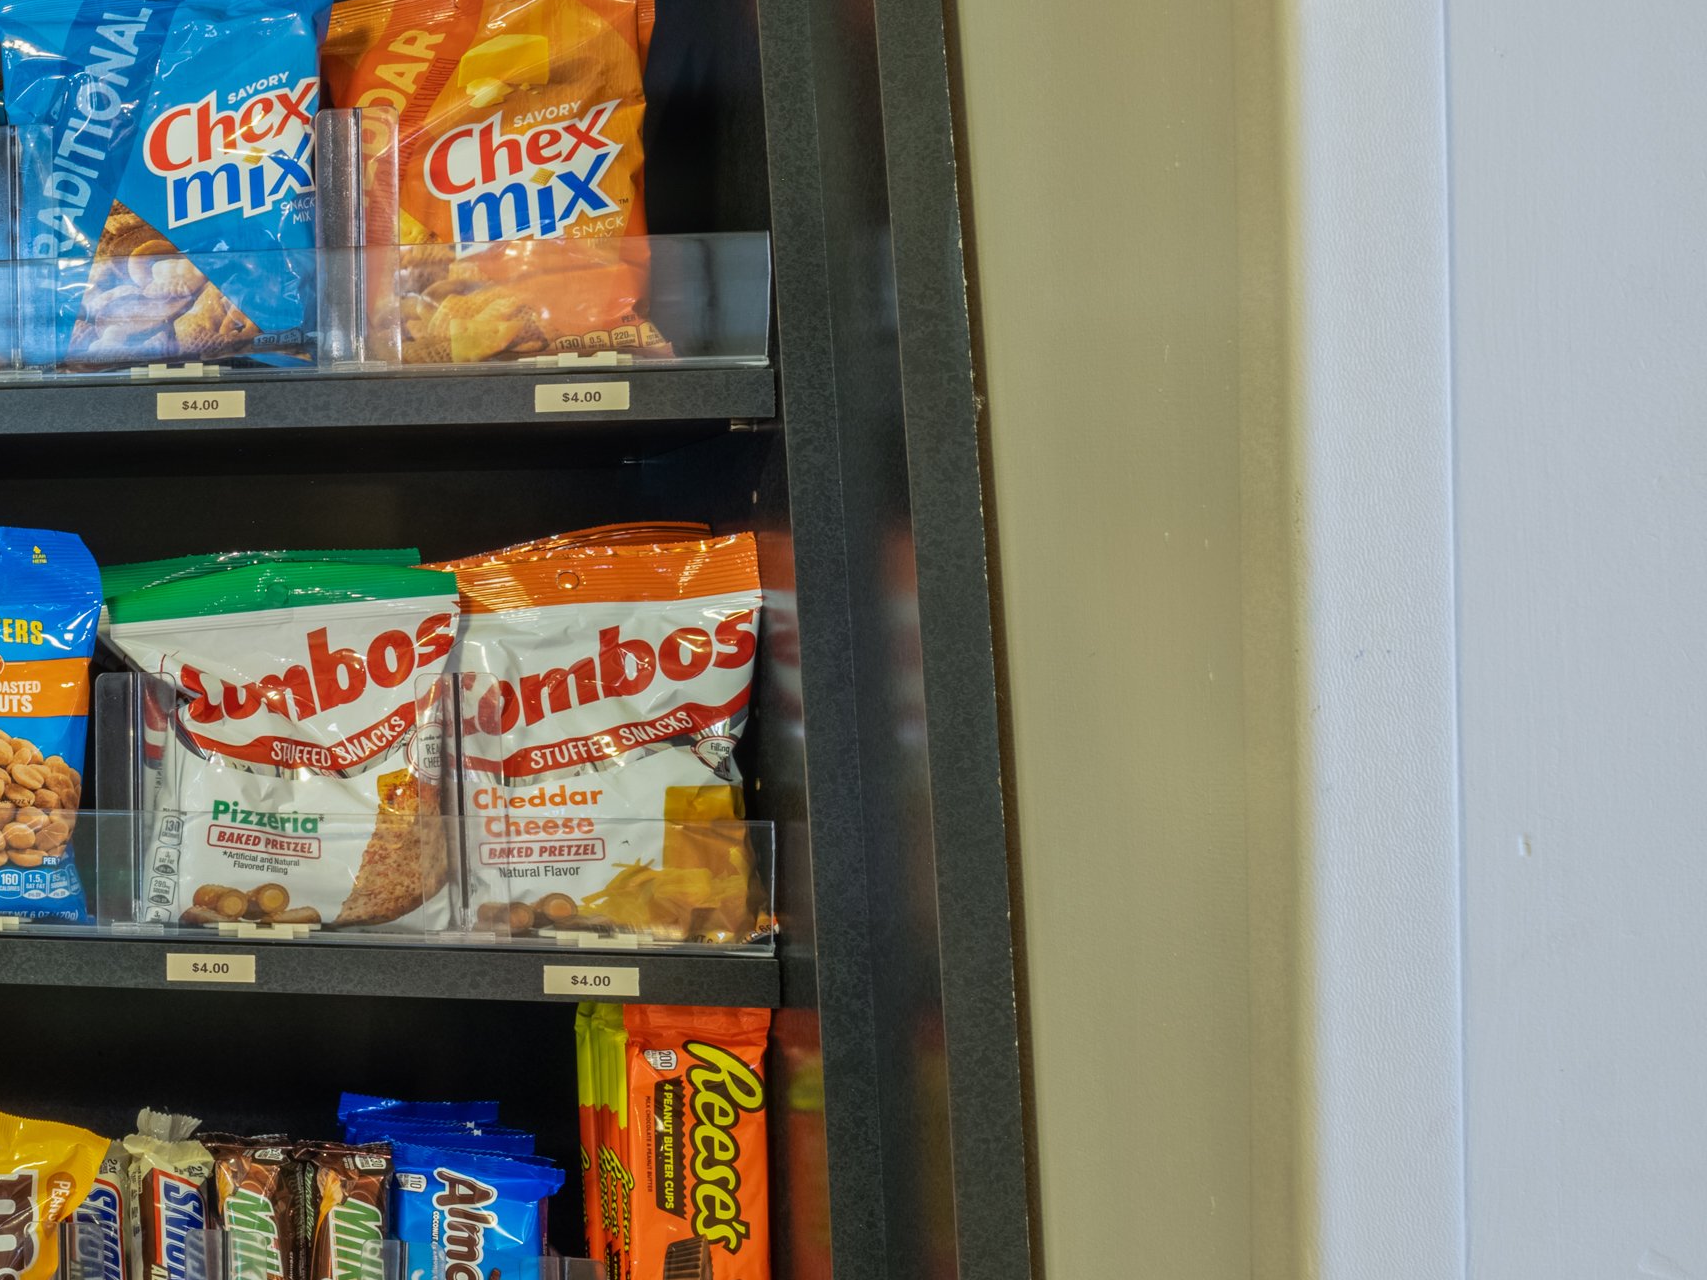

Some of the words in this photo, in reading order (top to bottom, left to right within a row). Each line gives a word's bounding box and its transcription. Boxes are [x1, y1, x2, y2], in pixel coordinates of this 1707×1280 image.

[513, 101, 582, 127] SAVORY
[428, 105, 616, 195] Chex
[458, 153, 613, 245] mix
[561, 391, 601, 403] $4.00
[472, 786, 603, 809] Cheddar
[484, 816, 595, 837] Cheese
[663, 1096, 673, 1129] PEANUT
[663, 1131, 673, 1166] BUTTER
[685, 1040, 763, 1255] Reese's
[663, 1180, 673, 1210] CUPS
